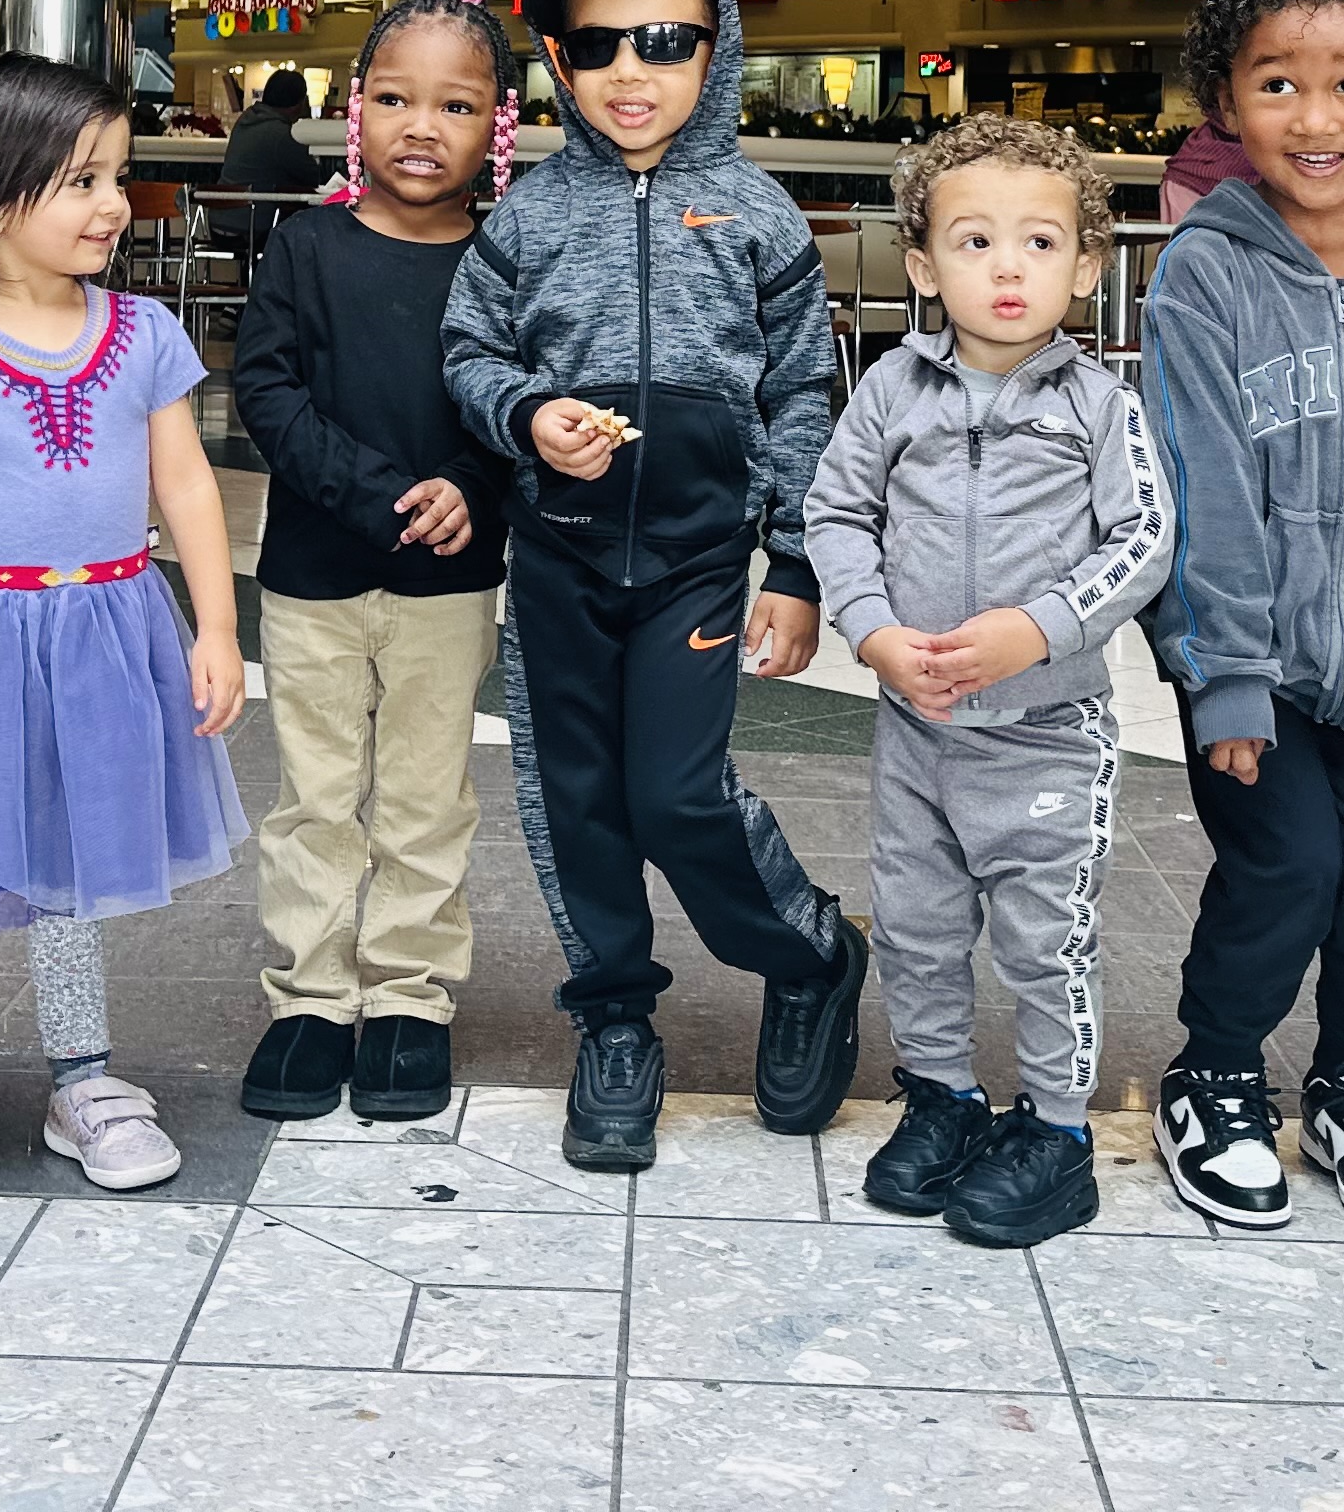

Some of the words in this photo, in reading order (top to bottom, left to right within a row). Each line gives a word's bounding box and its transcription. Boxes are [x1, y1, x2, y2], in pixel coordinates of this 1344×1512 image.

[204, 7, 302, 40] COOKIES
[1128, 406, 1142, 438] NIKE
[1130, 443, 1151, 473] NIKE
[1138, 478, 1155, 509] NIKE
[1127, 538, 1152, 564] NIK
[1102, 558, 1131, 591] NIKE
[1096, 758, 1115, 789] NIKE
[1094, 794, 1108, 829] NIKE
[1089, 834, 1108, 860] NIK
[1074, 865, 1089, 897] NIKE
[1069, 984, 1088, 1014] NIKE
[1076, 1056, 1091, 1087] NIKE
